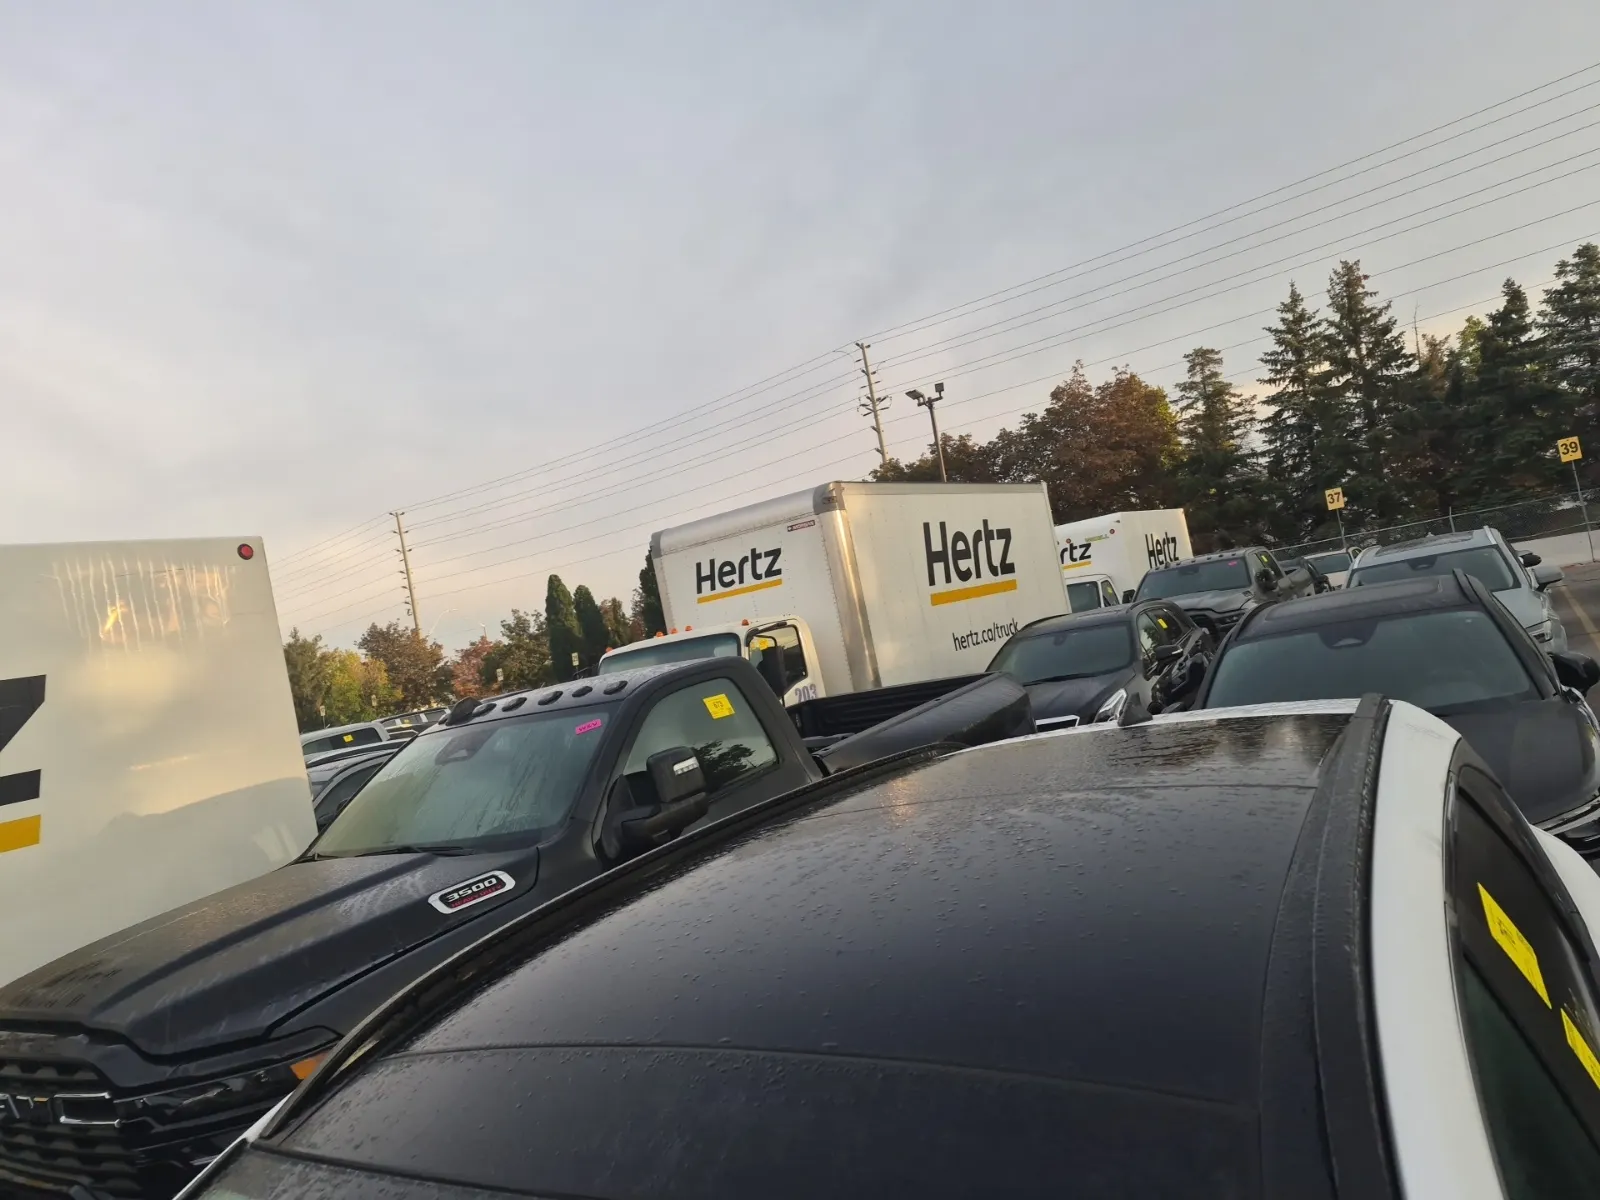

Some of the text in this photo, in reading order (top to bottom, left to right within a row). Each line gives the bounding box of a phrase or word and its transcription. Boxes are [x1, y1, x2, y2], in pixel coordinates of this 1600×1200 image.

[1560, 441, 1579, 455] 39
[1327, 491, 1341, 504] 37
[923, 519, 1015, 586] Hertz
[1145, 531, 1180, 568] Hertz
[696, 547, 782, 594] Hertz
[952, 617, 1019, 651] hertz.ca/truck
[445, 877, 497, 902] 3500
